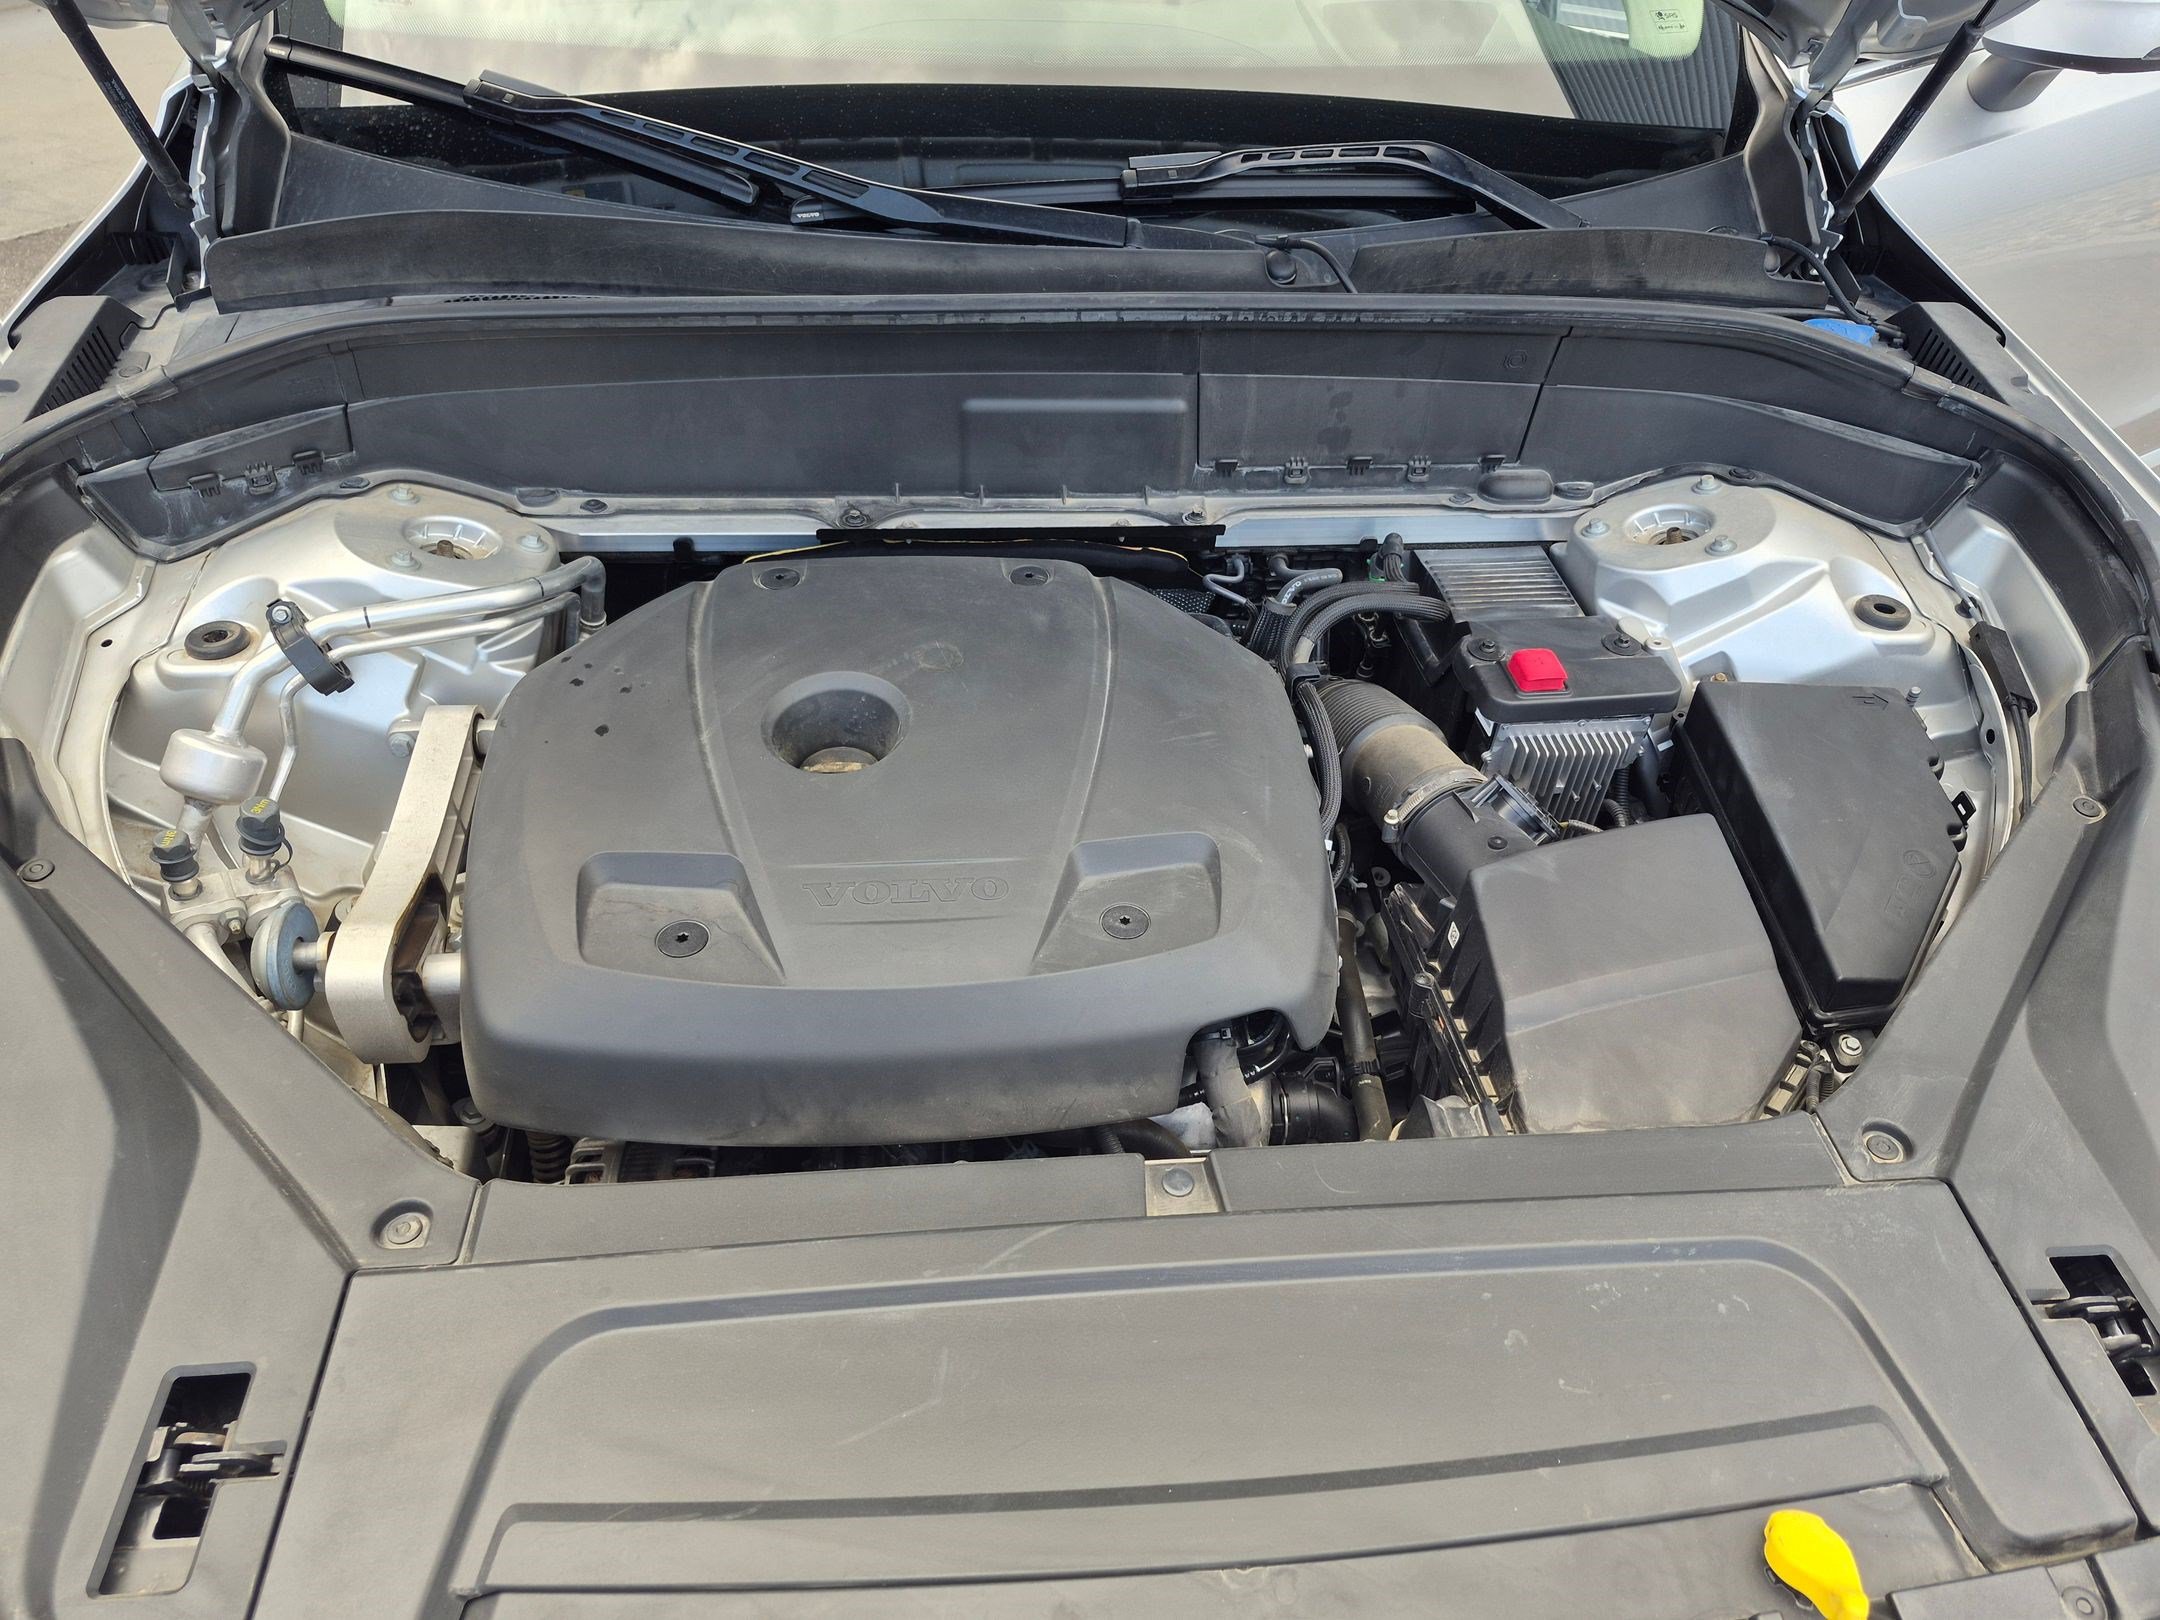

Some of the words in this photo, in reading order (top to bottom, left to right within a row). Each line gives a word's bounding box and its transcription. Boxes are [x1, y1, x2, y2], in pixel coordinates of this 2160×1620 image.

[797, 211, 820, 219] VOLVO
[1281, 580, 1302, 605] OLVO
[802, 876, 1010, 907] VOLVO
